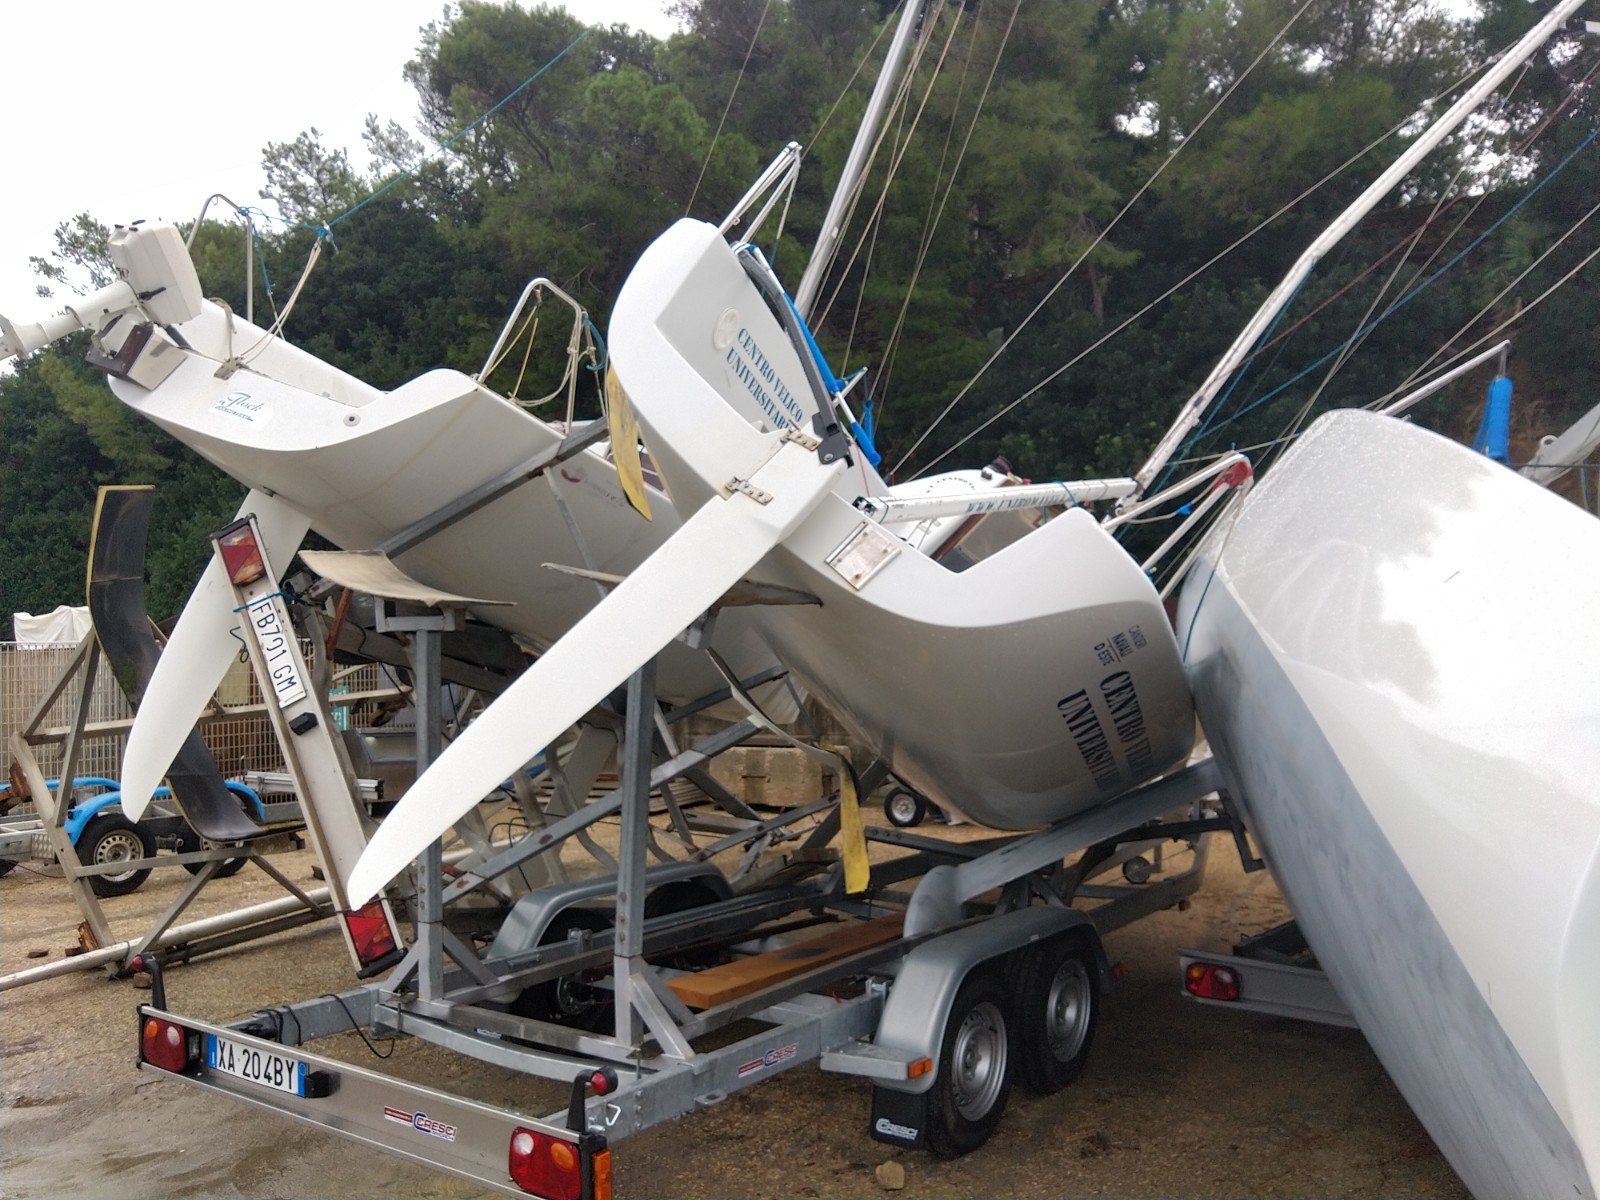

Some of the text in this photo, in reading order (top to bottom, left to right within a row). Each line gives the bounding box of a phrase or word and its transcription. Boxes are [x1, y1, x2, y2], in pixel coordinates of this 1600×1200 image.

[737, 328, 803, 423] CENTRO VELICO
[273, 664, 297, 693] GM
[1100, 670, 1147, 744] CENTRO
[218, 1039, 295, 1090] XA 204BY
[413, 1112, 458, 1137] CRESCI
[875, 1117, 919, 1138] CRESCI
